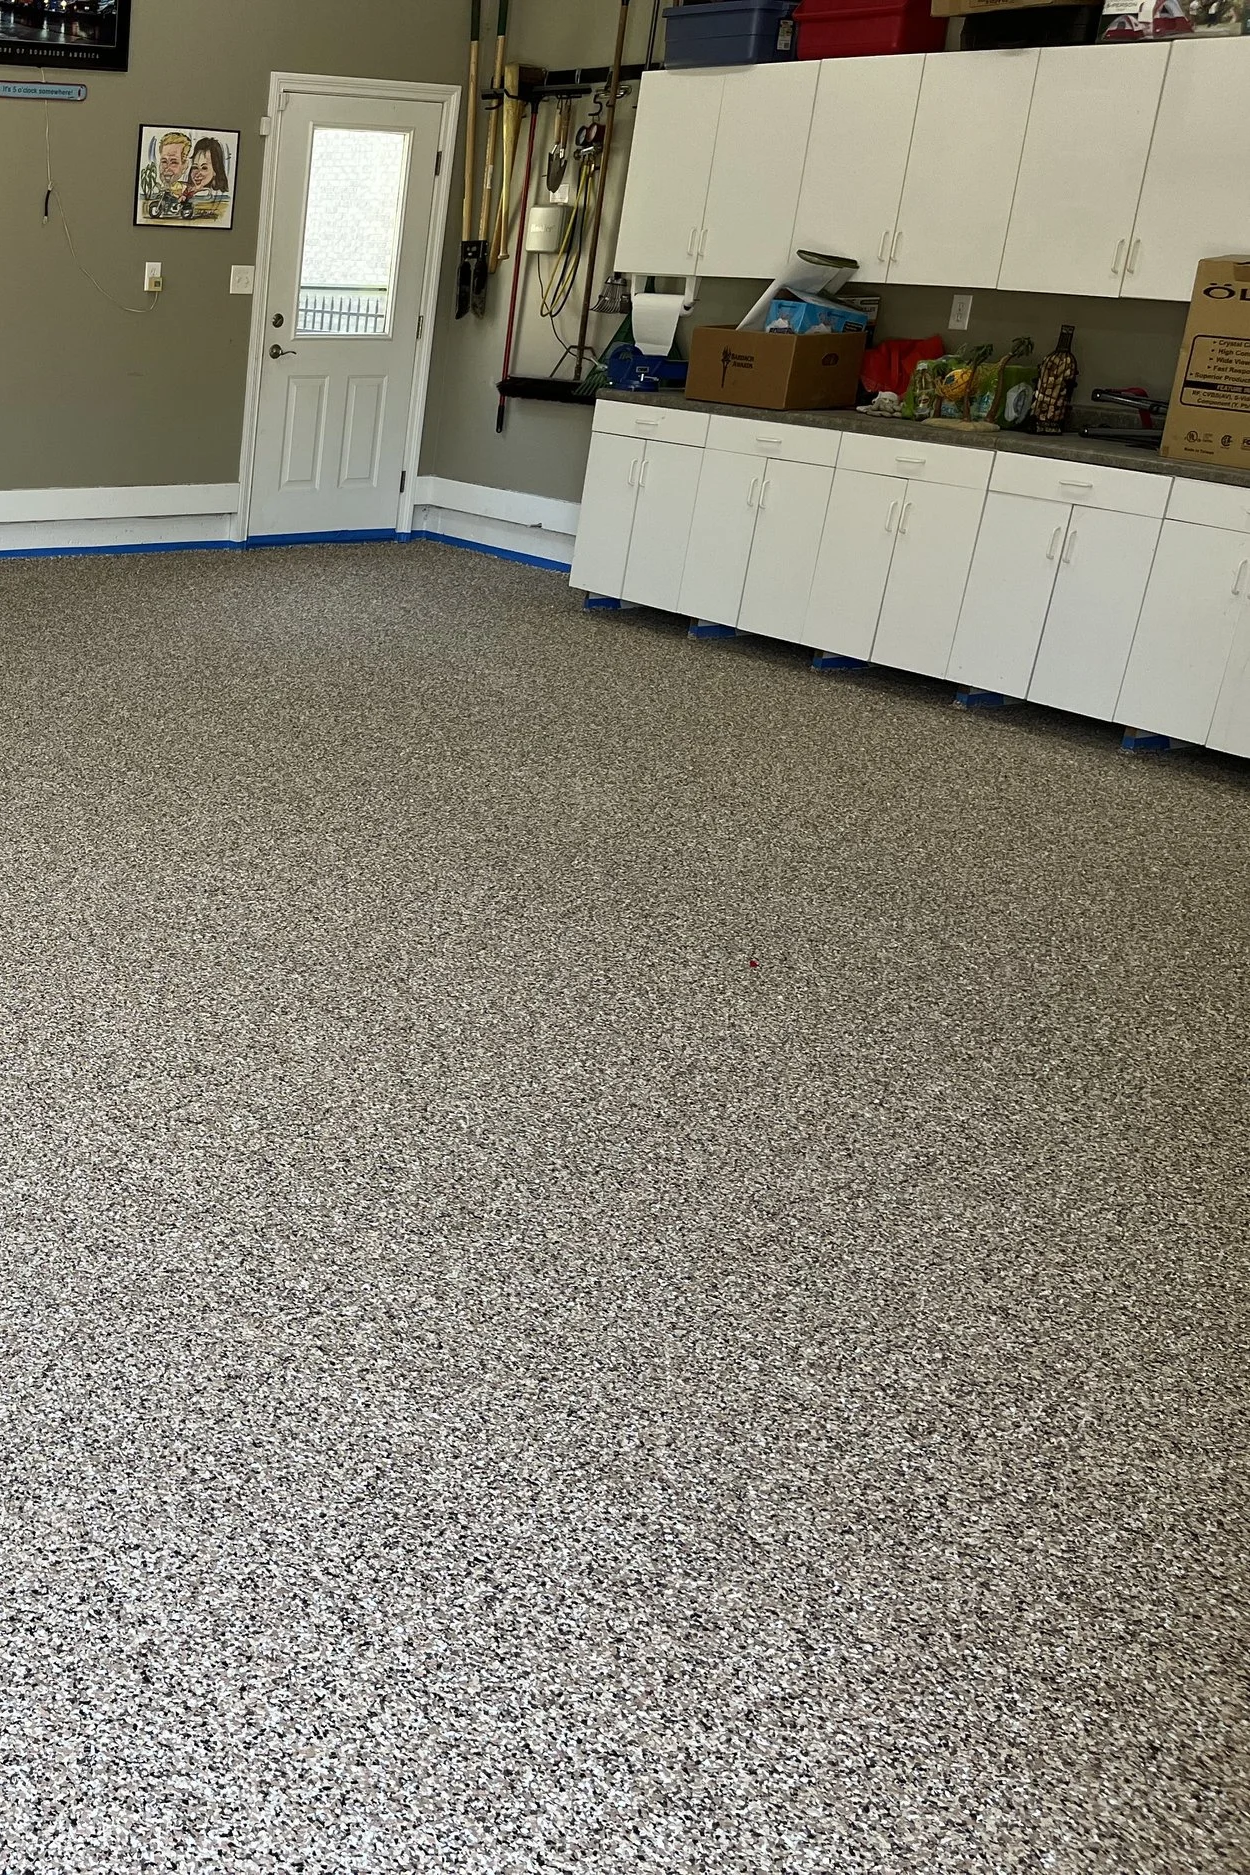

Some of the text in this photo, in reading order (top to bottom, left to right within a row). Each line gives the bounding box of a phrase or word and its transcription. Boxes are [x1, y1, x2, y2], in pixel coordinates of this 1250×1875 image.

[29, 49, 65, 57] ROADSIDE
[1218, 340, 1243, 348] Crystal
[1194, 372, 1223, 380] Superior
